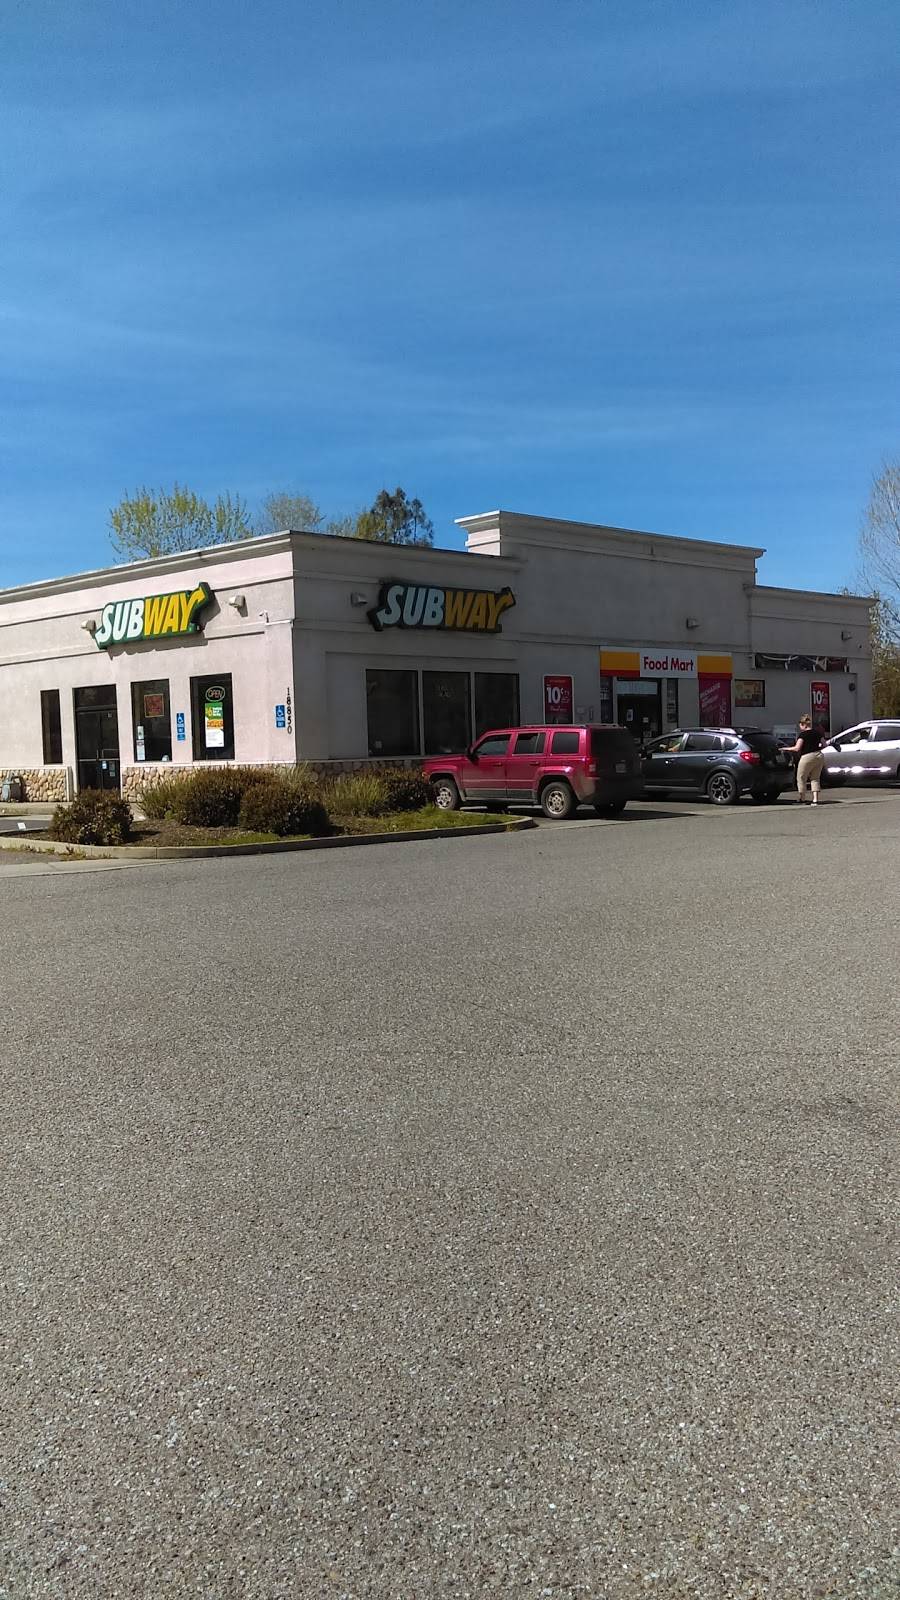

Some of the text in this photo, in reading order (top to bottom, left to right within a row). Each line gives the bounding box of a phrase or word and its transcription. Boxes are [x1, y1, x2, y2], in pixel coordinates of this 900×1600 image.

[95, 587, 206, 643] SUBWAY
[376, 585, 514, 627] SUBWAY
[643, 656, 694, 672] Food Mart
[208, 689, 223, 698] OPEN
